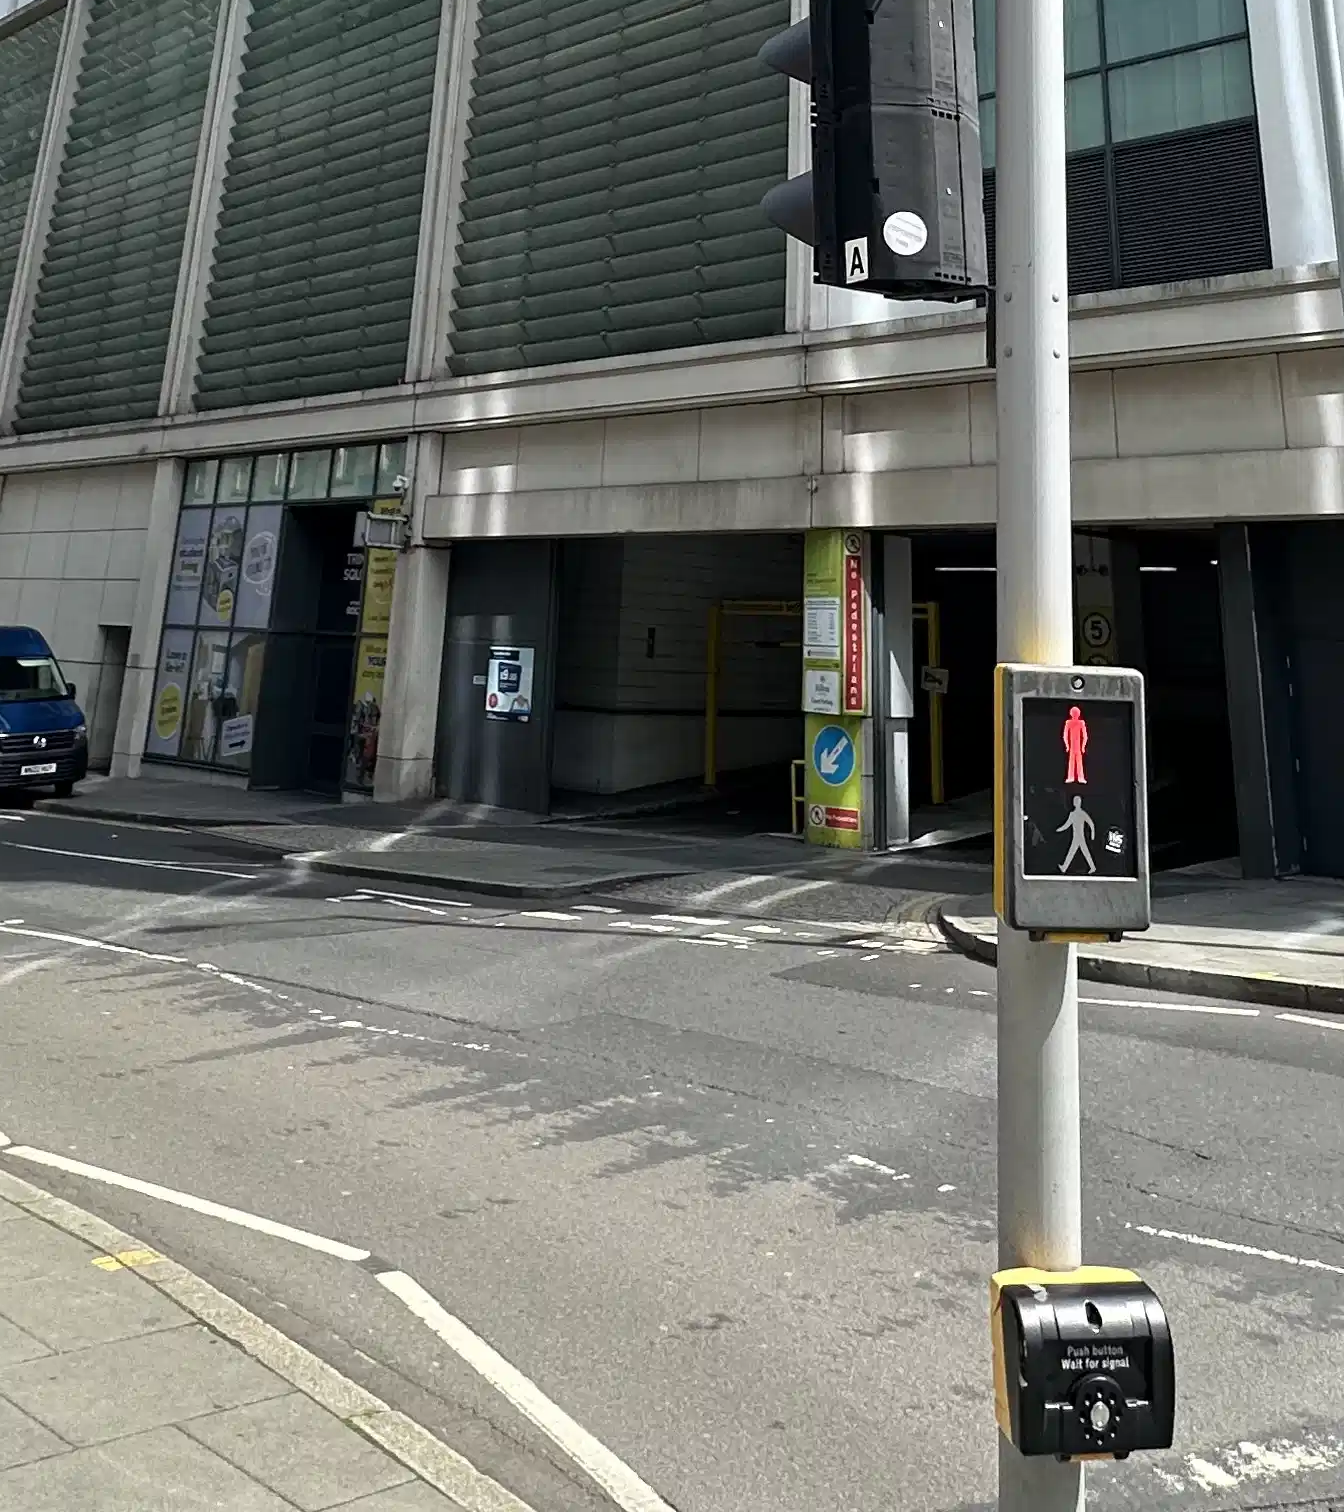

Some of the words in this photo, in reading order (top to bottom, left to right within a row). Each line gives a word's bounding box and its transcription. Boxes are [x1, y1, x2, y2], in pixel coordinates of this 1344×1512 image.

[850, 246, 864, 276] A
[1091, 620, 1103, 640] 5
[1067, 1345, 1090, 1357] Push
[1092, 1344, 1124, 1355] button
[1061, 1358, 1083, 1370] Wait
[1085, 1357, 1099, 1369] for
[1102, 1355, 1129, 1370] signal
